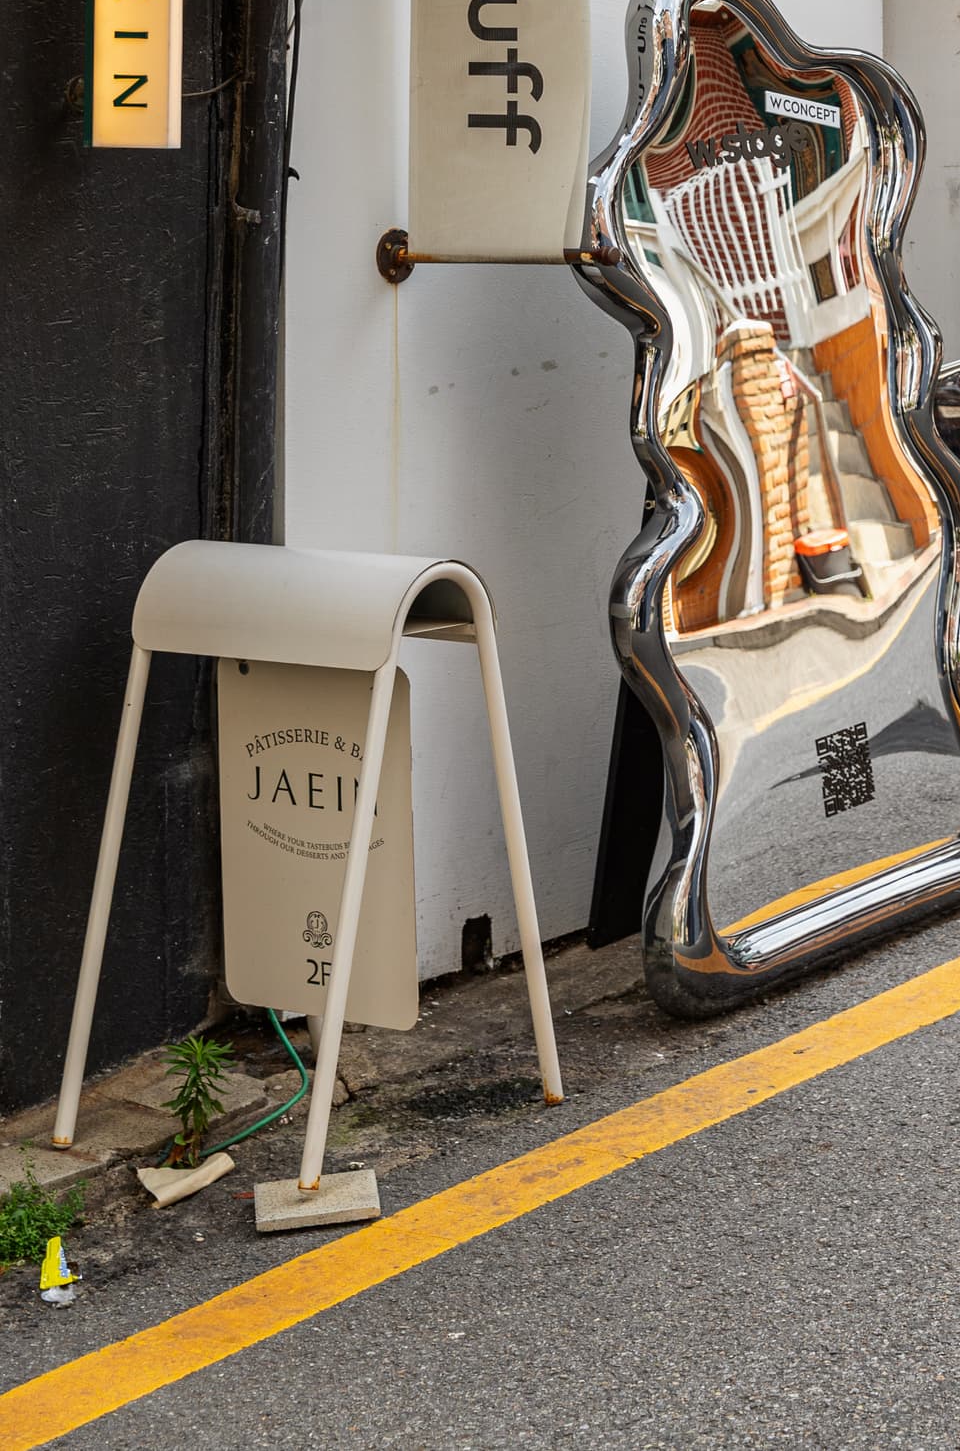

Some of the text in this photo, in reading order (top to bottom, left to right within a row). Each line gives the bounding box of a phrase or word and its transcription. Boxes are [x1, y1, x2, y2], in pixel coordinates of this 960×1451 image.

[245, 728, 329, 758] PÂTISSERIE
[334, 735, 346, 752] &
[247, 819, 280, 847] THROUGH
[280, 842, 296, 854] OUR
[330, 852, 346, 861] AND
[263, 822, 287, 842] WHERE
[287, 835, 306, 849] YOUR
[306, 958, 332, 987] 2F
